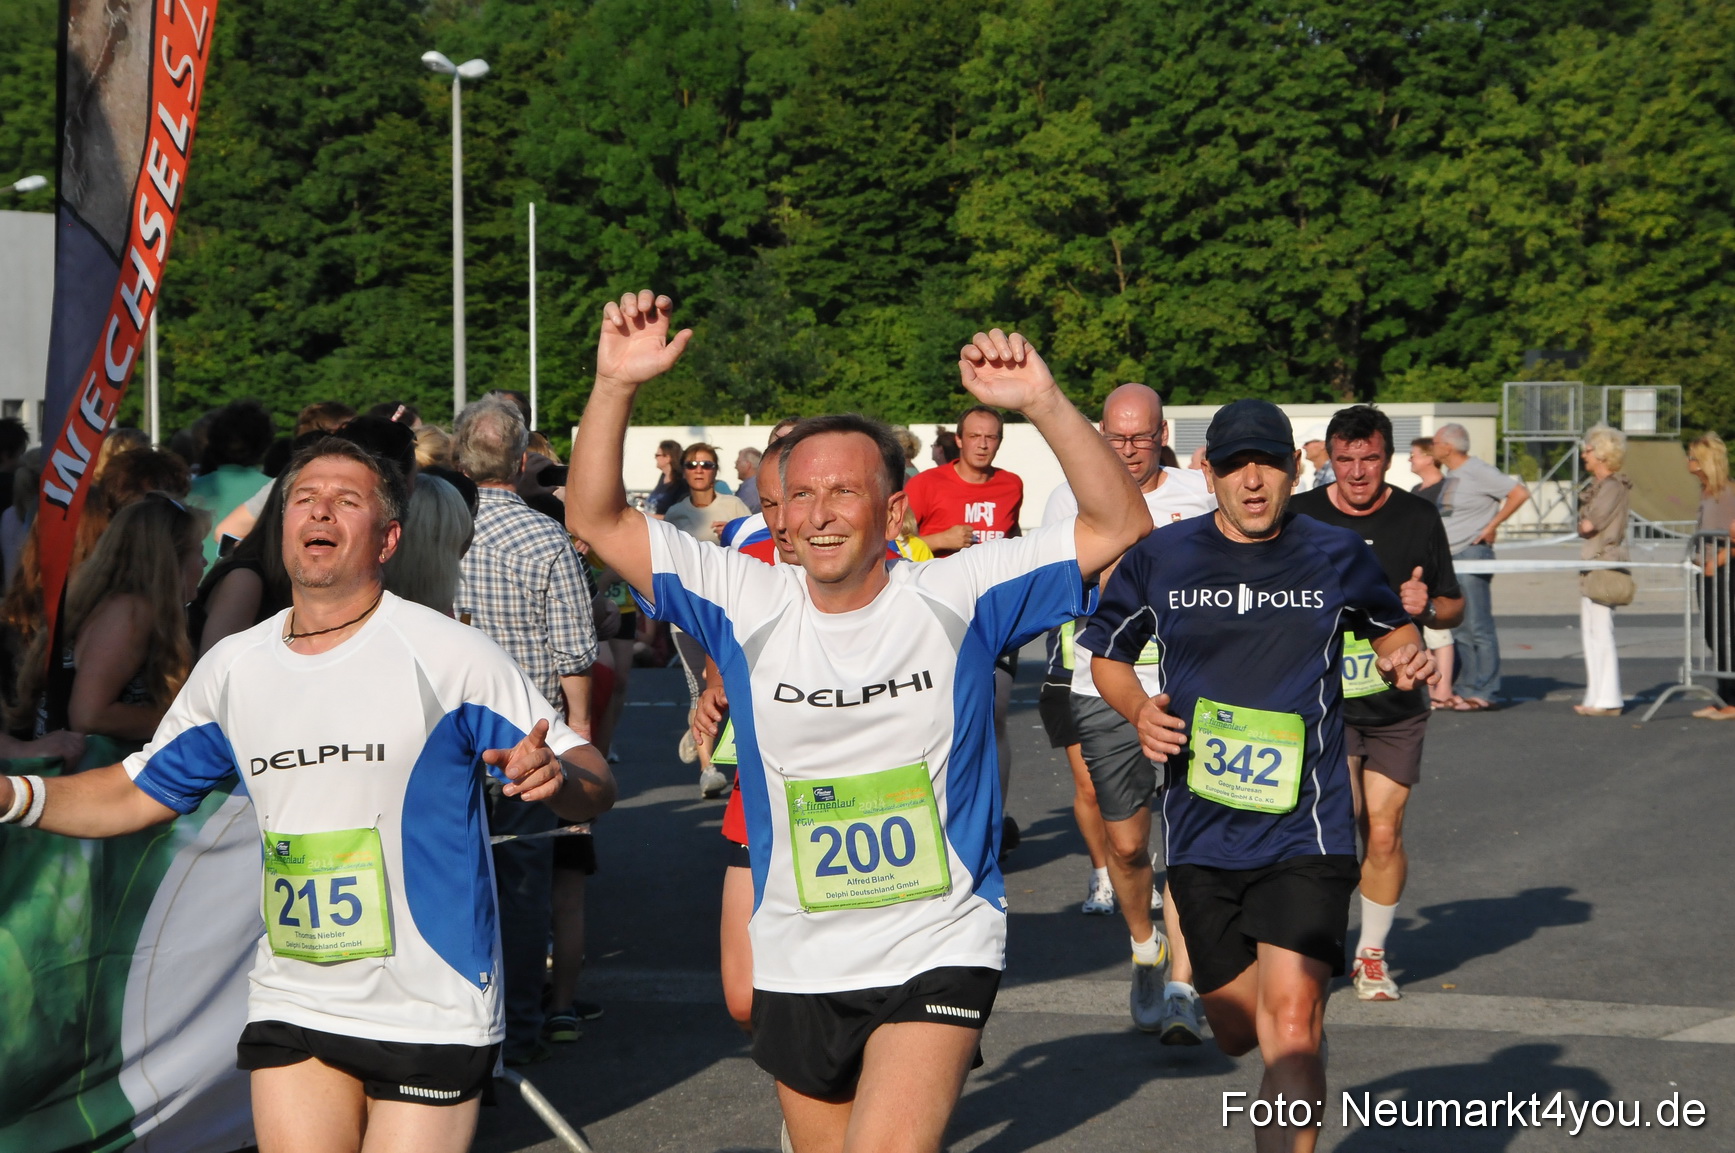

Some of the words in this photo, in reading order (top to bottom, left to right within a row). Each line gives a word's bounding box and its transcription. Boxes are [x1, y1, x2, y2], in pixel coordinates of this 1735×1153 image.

[1168, 589, 1233, 610] EURO
[1257, 590, 1324, 609] POLES
[773, 669, 934, 708] DELPHI
[250, 743, 385, 777] DELPHI
[1203, 737, 1282, 788] 342
[1205, 785, 1230, 797] Europoles
[1230, 792, 1248, 801] GmbH
[1217, 780, 1235, 791] Georg
[1235, 785, 1263, 794] Muresan
[806, 797, 856, 811] firmenlauf
[810, 815, 916, 878] 200
[846, 876, 871, 886] Alfred
[871, 873, 895, 884] Blank
[825, 889, 849, 899] Delphi
[850, 885, 895, 897] Deutschland
[896, 880, 920, 890] GmbH
[274, 876, 363, 929] 215
[294, 931, 316, 940] Thomas
[317, 931, 346, 940] Niebler
[285, 940, 301, 949] Delphi
[301, 942, 339, 951] Deutschland
[339, 940, 362, 948] GmbH
